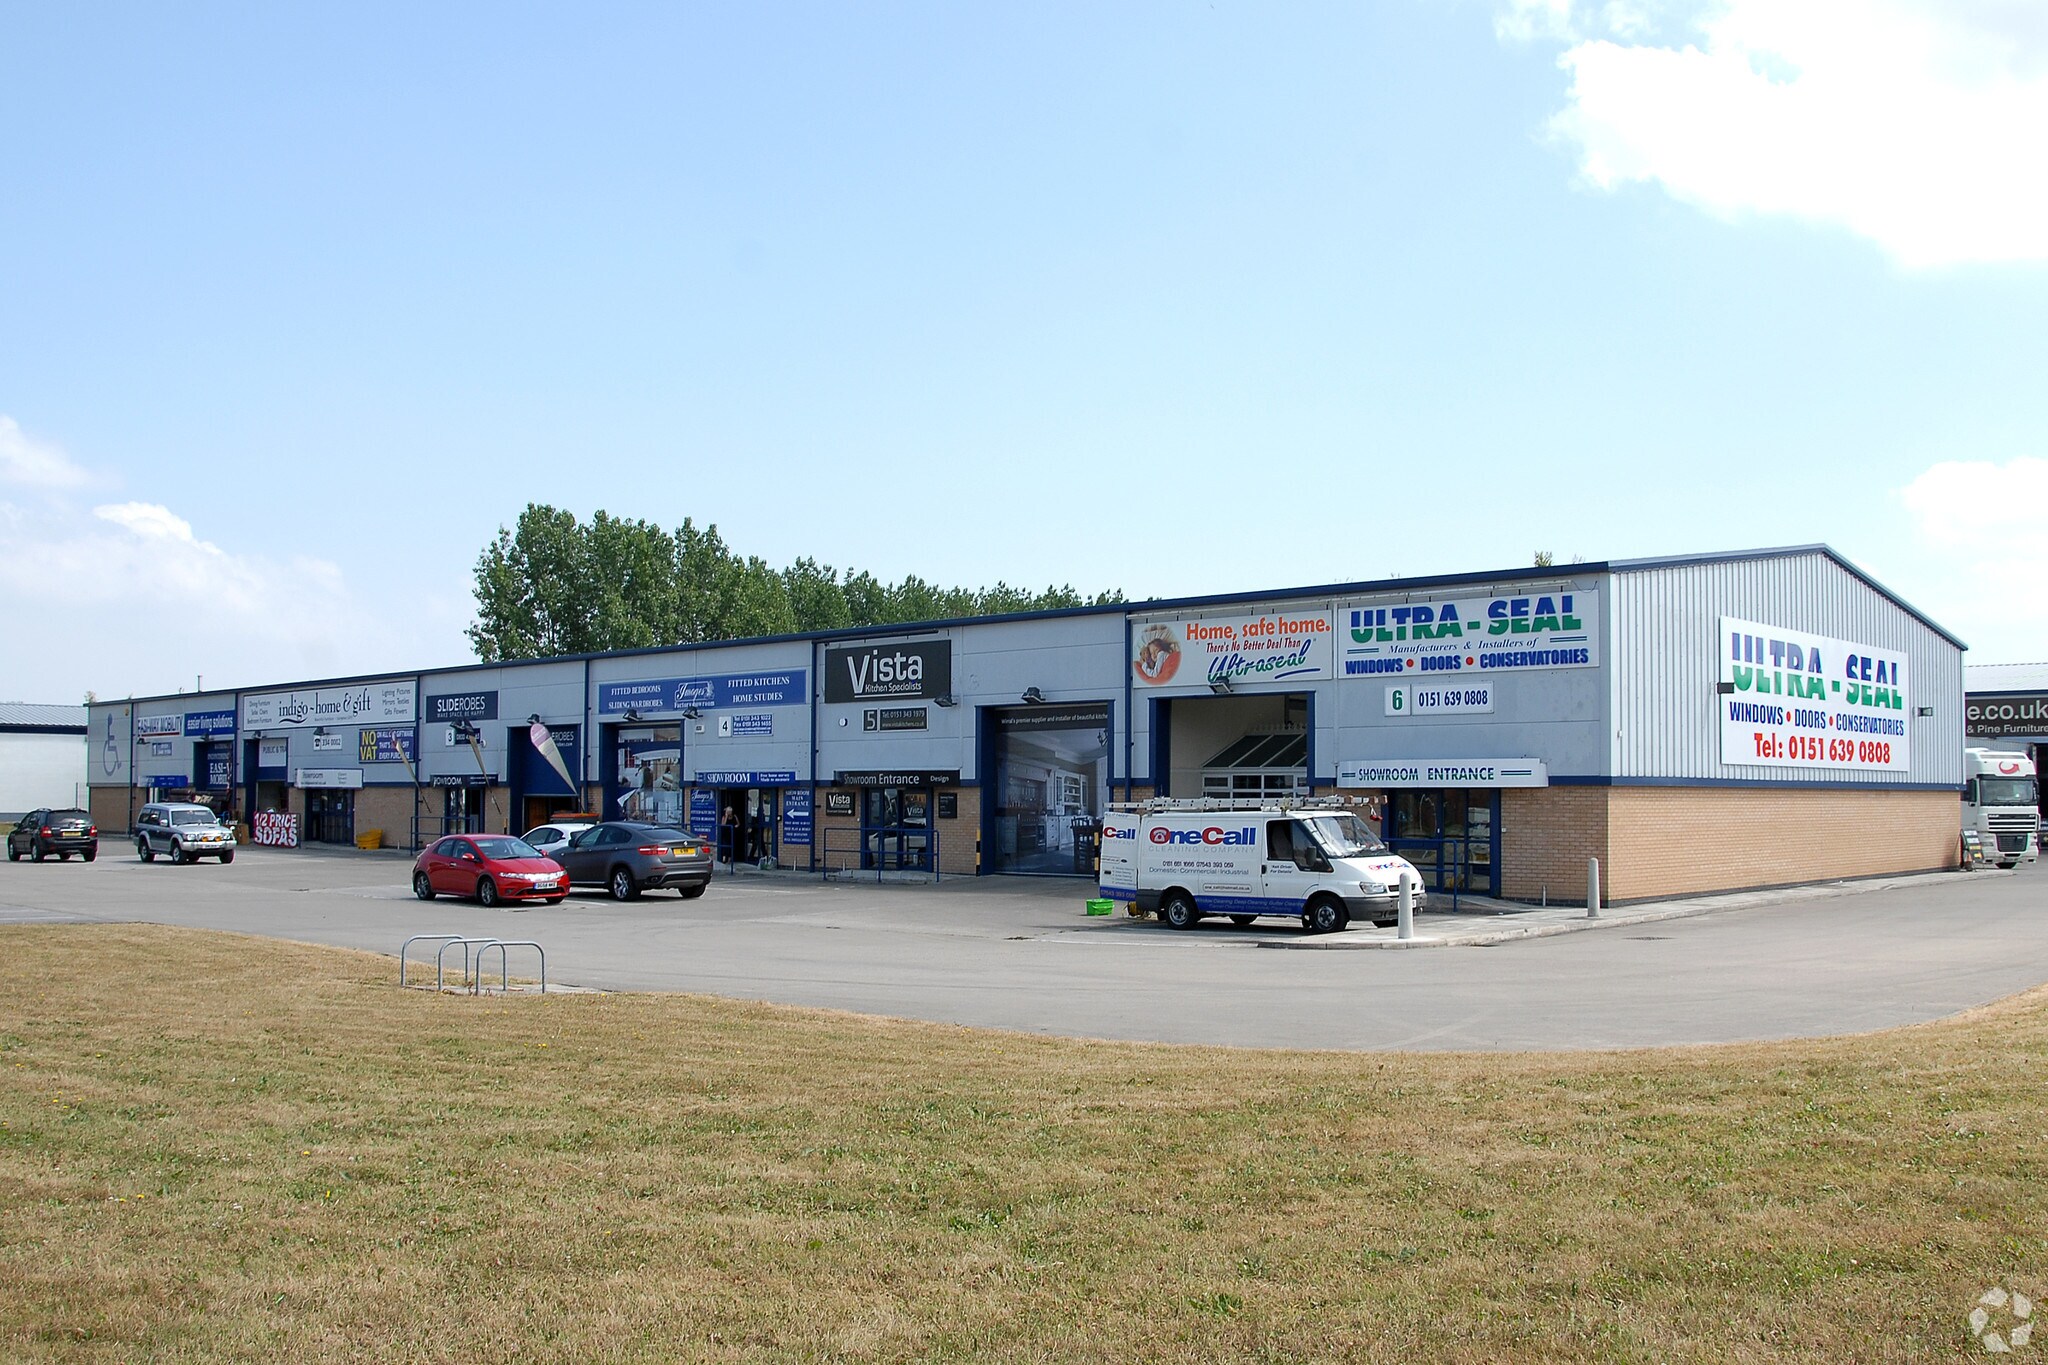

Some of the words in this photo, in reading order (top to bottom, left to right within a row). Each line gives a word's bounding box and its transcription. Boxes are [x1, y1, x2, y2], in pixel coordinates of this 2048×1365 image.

[1351, 604, 1463, 644] ULTRA
[1488, 595, 1581, 636] SEAL
[1186, 623, 1238, 643] Home,
[1242, 617, 1274, 638] safe
[1279, 617, 1331, 636] home.
[1206, 642, 1229, 653] There's
[1231, 641, 1240, 652] No
[1243, 639, 1264, 651] Better
[1266, 638, 1282, 650] Deal
[1284, 637, 1301, 649] Than
[1388, 643, 1457, 656] Manufacturers
[1463, 641, 1472, 650] &
[1478, 638, 1525, 650] Installers
[1526, 637, 1539, 650] of
[1207, 639, 1311, 682] Ultraseal
[1345, 657, 1404, 675] WINDOWS
[1421, 655, 1462, 672] DOORS
[1480, 648, 1589, 669] CONSERVATORIES
[847, 649, 923, 694] Vista
[1731, 632, 1826, 700] ULTRA
[1846, 654, 1903, 710] SEAL
[728, 678, 753, 688] FITTED
[754, 676, 790, 687] KITCHENS
[865, 683, 888, 693] Kitchen
[889, 681, 922, 693] Specialists
[611, 686, 631, 696] FITTED
[631, 684, 661, 695] BEDROOMS
[732, 693, 755, 703] HOME
[756, 691, 783, 702] STUDIES
[279, 694, 309, 721] indigo
[315, 692, 341, 714] home
[353, 688, 371, 717] gift
[437, 696, 486, 712] SLIDEROBES
[608, 700, 630, 710] SLIDING
[630, 699, 663, 709] WARDROBES
[1392, 689, 1403, 711] 6
[1418, 691, 1441, 707] 0151
[1444, 690, 1462, 707] 639
[1464, 689, 1488, 706] 0808
[1966, 700, 2048, 721] e.co.uk
[187, 716, 200, 730] easier
[200, 715, 212, 732] living
[212, 714, 233, 728] solutions
[722, 720, 728, 732] 4
[867, 711, 875, 730] 5
[1016, 717, 1031, 725] premier
[1031, 716, 1047, 724] supplier
[1055, 714, 1072, 722] installer
[1077, 713, 1095, 721] beautiful
[1729, 702, 1783, 726] WINDOWS
[1794, 708, 1826, 729] DOORS
[1836, 713, 1904, 737] CONSERVATORIES
[1967, 724, 1974, 734] &
[1977, 724, 2001, 734] Pine
[2004, 723, 2048, 734] Furniture
[362, 730, 376, 745] NO
[447, 732, 453, 742] 3
[360, 746, 377, 761] VAT
[1754, 733, 1783, 759] Tel:
[1789, 735, 1824, 760] 0151
[1829, 738, 1854, 762] 639
[1859, 740, 1890, 764] 0808
[707, 772, 750, 783] SHOWROOM
[844, 774, 877, 785] Showroom
[879, 773, 920, 785] Entrance
[930, 775, 949, 784] Design
[1359, 767, 1419, 781] SHOWROOM
[1428, 767, 1495, 781] ENTRANCE
[828, 793, 851, 807] Vista
[269, 813, 297, 827] PRICE
[254, 826, 298, 848] SOFAS
[1103, 826, 1136, 840] Call
[1149, 826, 1257, 845] OneCall
[1204, 846, 1257, 854] COMPANY
[1149, 866, 1177, 874] Domestic
